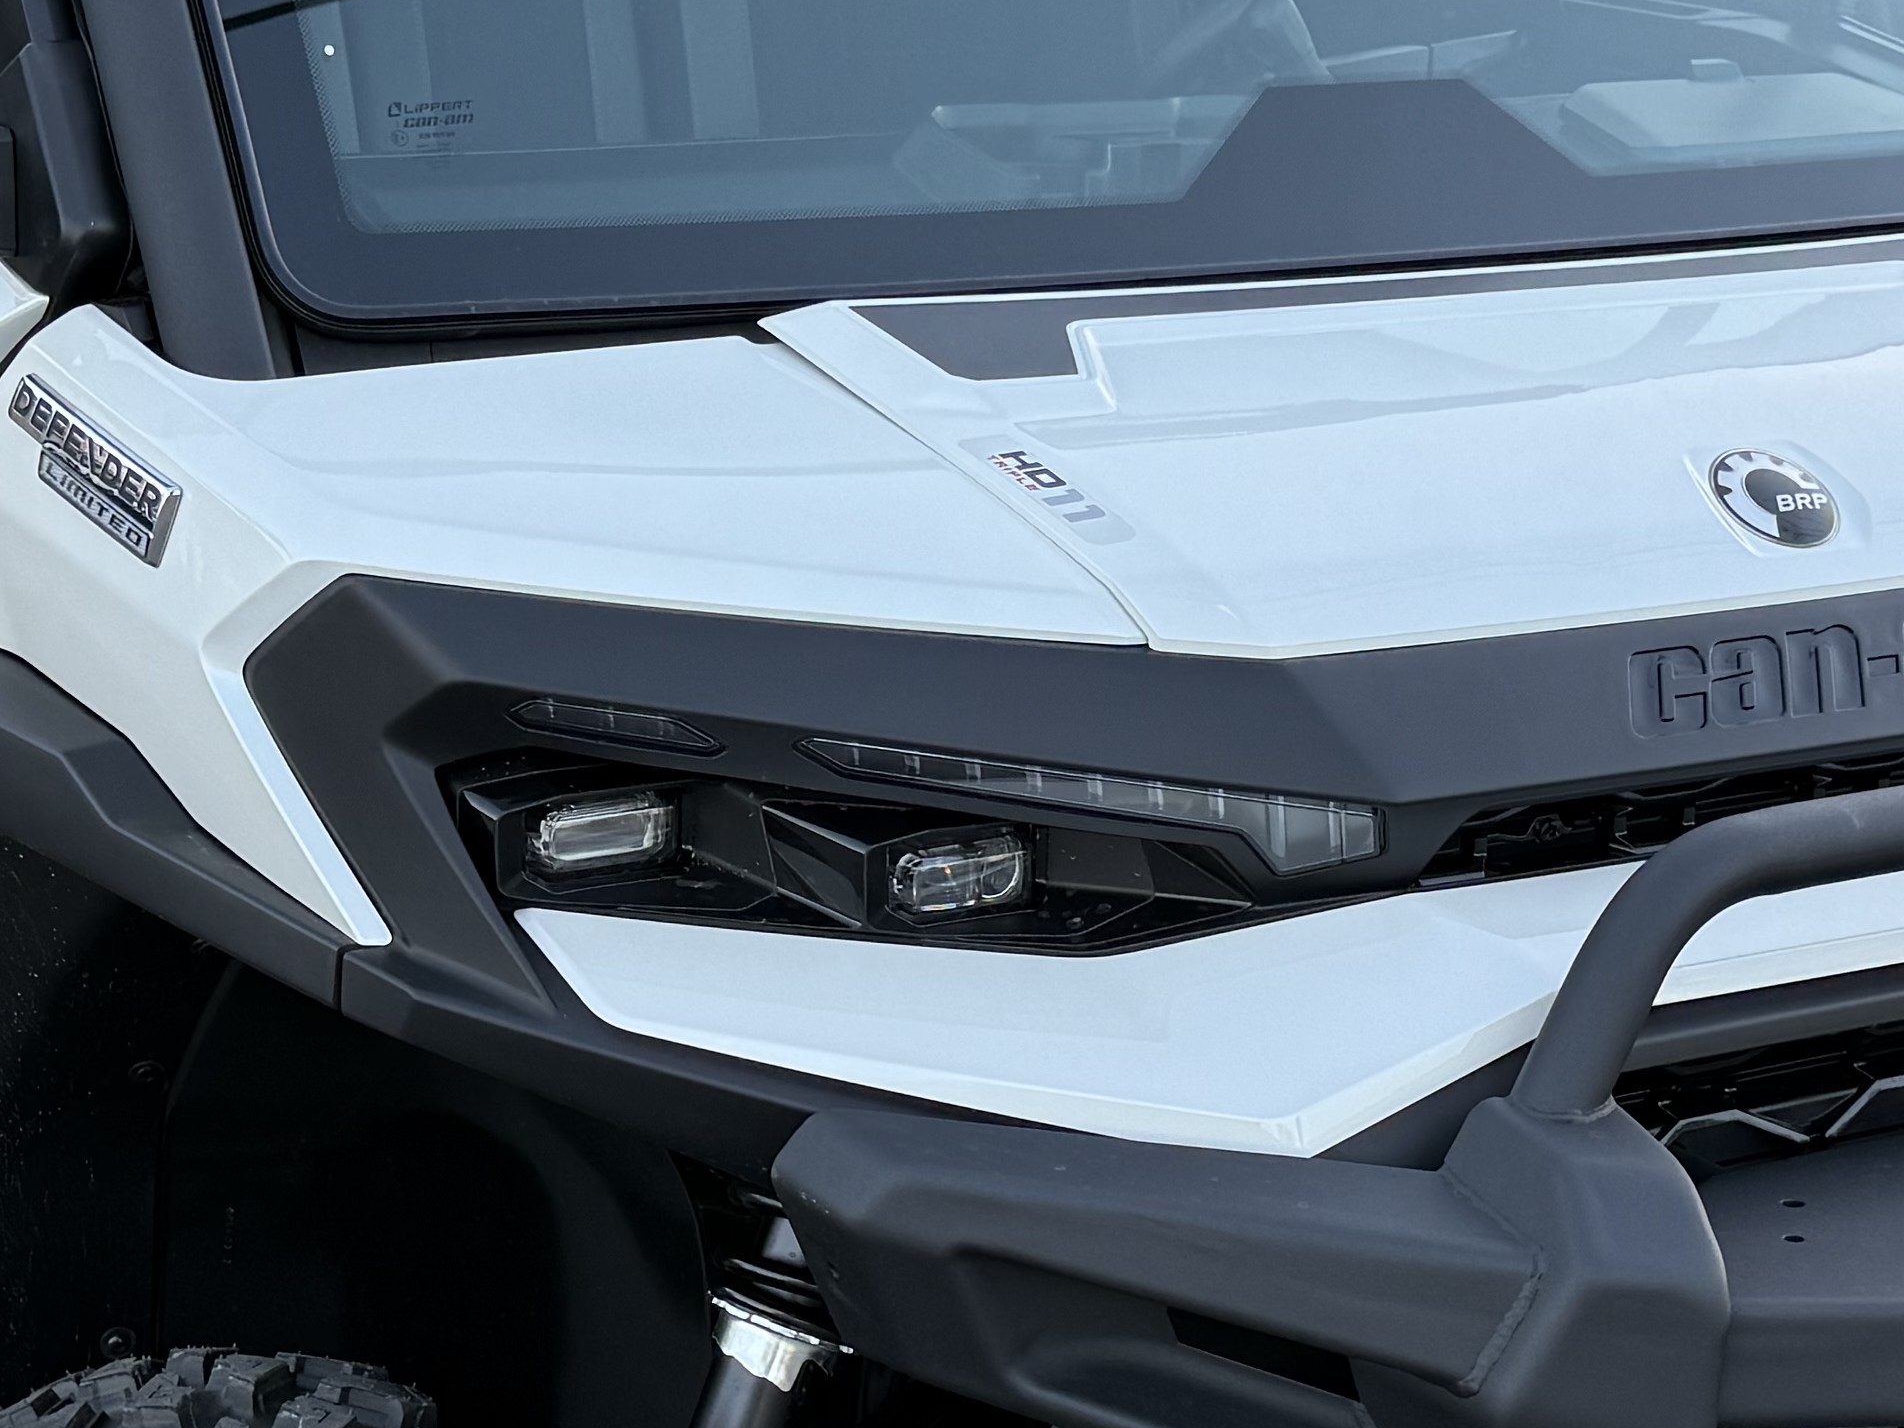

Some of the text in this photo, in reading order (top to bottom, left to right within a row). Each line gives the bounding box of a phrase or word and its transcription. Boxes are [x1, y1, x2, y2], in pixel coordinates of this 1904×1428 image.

[13, 383, 163, 521] DEFENDER
[46, 462, 143, 547] LIMITED
[1775, 492, 1828, 513] BRP
